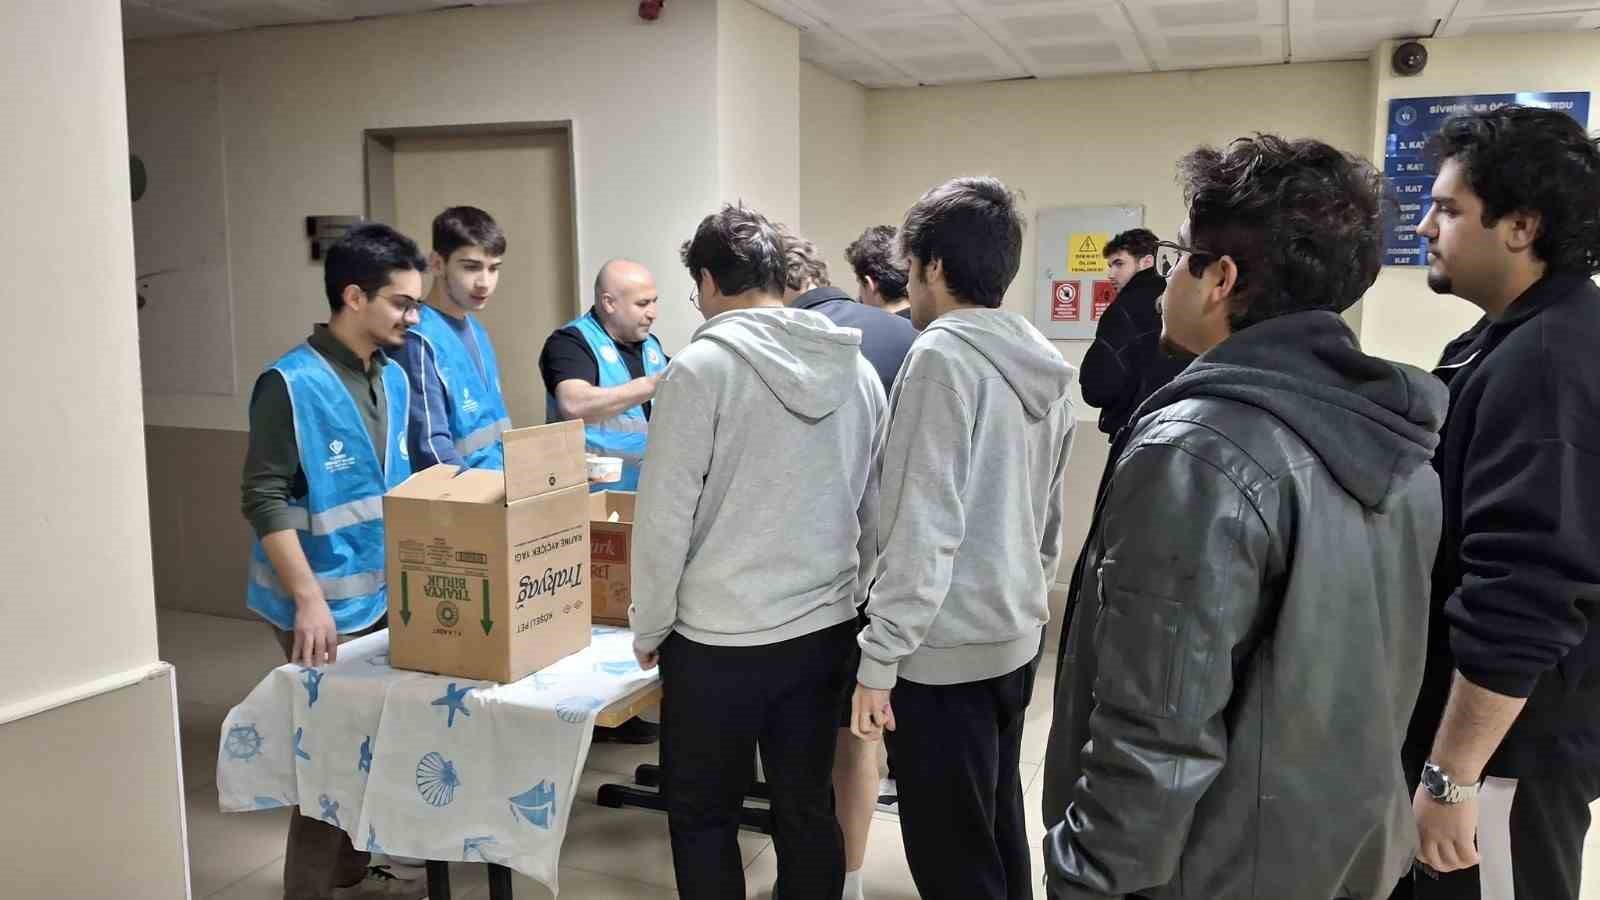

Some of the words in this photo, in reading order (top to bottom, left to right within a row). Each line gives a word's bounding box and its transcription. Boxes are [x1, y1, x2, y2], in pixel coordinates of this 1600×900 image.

[1406, 163, 1424, 171] KAT
[423, 586, 472, 602] TRAKYA
[515, 563, 584, 611] Trakyağ
